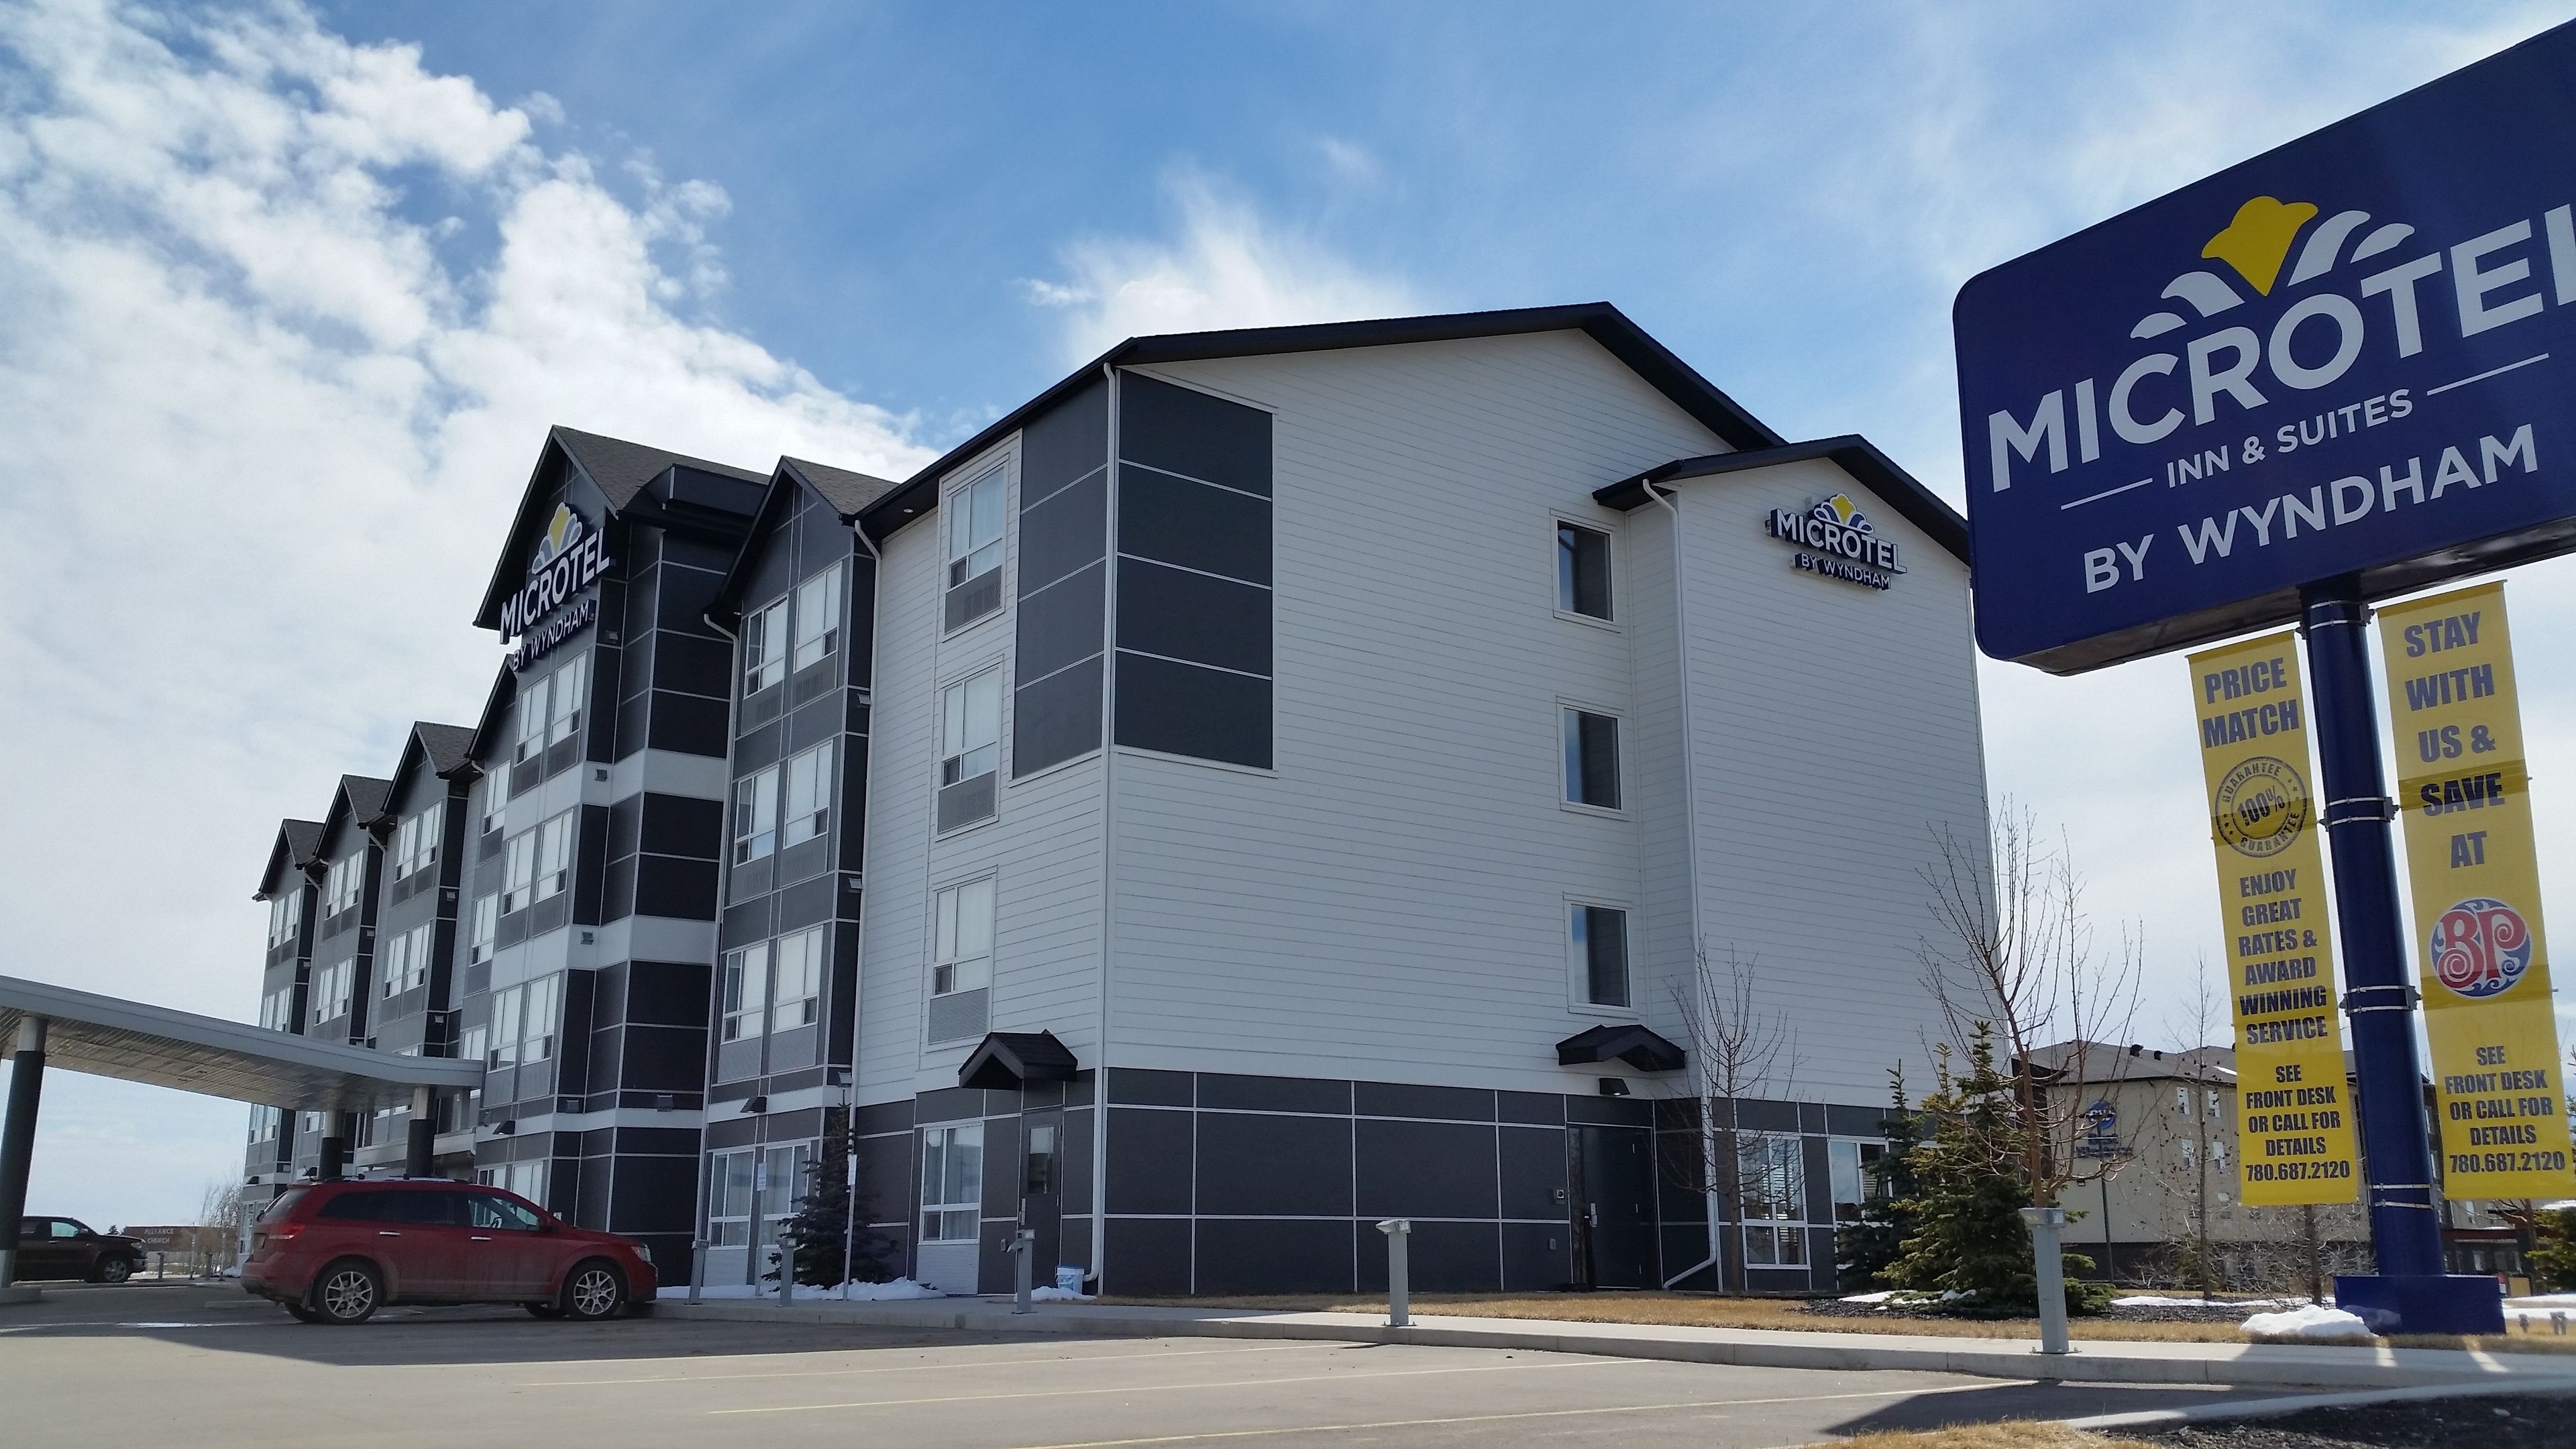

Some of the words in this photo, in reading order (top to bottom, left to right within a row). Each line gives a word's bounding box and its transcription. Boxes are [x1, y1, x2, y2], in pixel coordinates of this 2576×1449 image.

[2167, 444, 2231, 488] INN
[2242, 436, 2266, 466] &
[2277, 388, 2413, 455] SUITES
[2084, 533, 2155, 594] BY
[2178, 423, 2539, 566] WYNDHAM
[1771, 508, 1907, 574] MICROTEL
[500, 527, 610, 645] MICROTEL
[1798, 553, 1817, 570] BY
[1819, 559, 1891, 590] WYNDHAM
[513, 644, 527, 672] BY
[530, 599, 590, 659] WYNDHAM
[2404, 611, 2481, 658] STAY
[2204, 657, 2287, 704] PRICE
[2405, 663, 2496, 712] WITH
[2202, 699, 2300, 749] MATCH
[2418, 724, 2463, 763] US
[2471, 724, 2496, 754] &
[2221, 763, 2282, 804] GUARANTEE
[2420, 772, 2506, 817] SAVE
[2237, 785, 2286, 827] 100%
[2240, 812, 2300, 852] GUARANTEE
[2451, 830, 2487, 869] AT
[2239, 868, 2297, 898] ENJOY
[2242, 898, 2302, 927] GREAT
[2239, 929, 2298, 957] RATES
[2302, 929, 2318, 948] &
[2436, 908, 2526, 989] BP
[2245, 957, 2316, 986] AWARD
[2239, 985, 2327, 1016] WINNING
[2247, 1016, 2328, 1045] SERVICE
[2275, 1064, 2302, 1083] SEE
[2475, 1046, 2506, 1066] SEE
[2246, 1089, 2293, 1109] FRONT
[2297, 1086, 2337, 1106] DESK
[2445, 1073, 2497, 1095] FRONT
[2500, 1069, 2548, 1090] DESK
[2248, 1116, 2269, 1133] OR
[2272, 1113, 2308, 1132] CALL
[2312, 1111, 2341, 1129] FOR
[2449, 1102, 2473, 1120] OR
[2475, 1098, 2516, 1119] CALL
[2518, 1096, 2553, 1117] FOR
[2265, 1136, 2326, 1157] DETAILS
[2469, 1124, 2537, 1146] DETAILS
[2246, 1160, 2350, 1182] 780.687.2120
[2449, 1150, 2566, 1173] 780.687.2120
